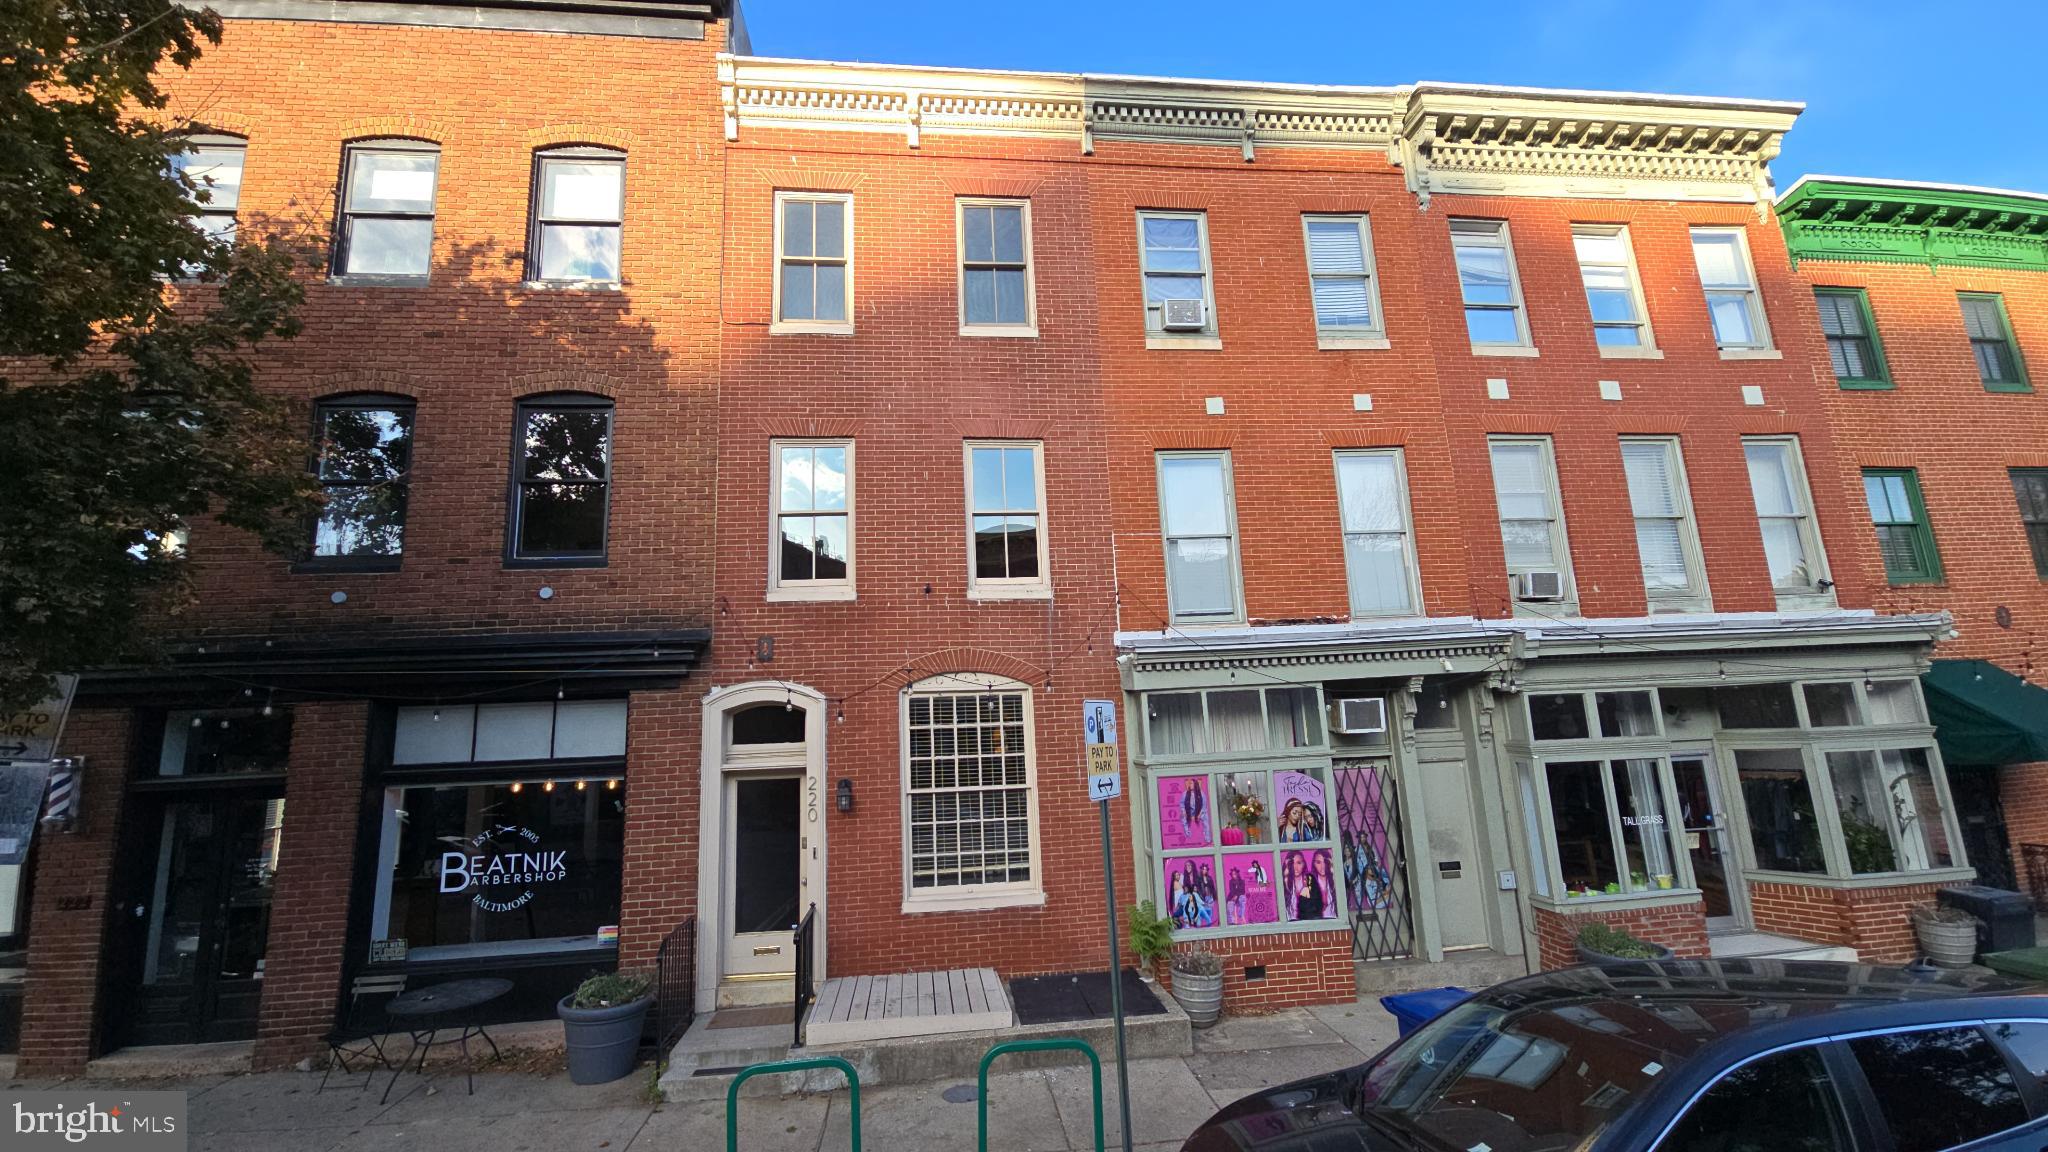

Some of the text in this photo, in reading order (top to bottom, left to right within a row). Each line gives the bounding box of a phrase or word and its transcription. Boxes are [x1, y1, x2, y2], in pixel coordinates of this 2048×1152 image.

[0, 712, 50, 725] AY TO
[0, 725, 38, 737] ARK
[1091, 746, 1114, 759] PAY TO
[1095, 760, 1113, 773] PARK
[807, 776, 818, 823] 220
[520, 827, 540, 844] 2005
[440, 850, 566, 893] BEATNIK
[472, 890, 534, 912] BALTIMORE
